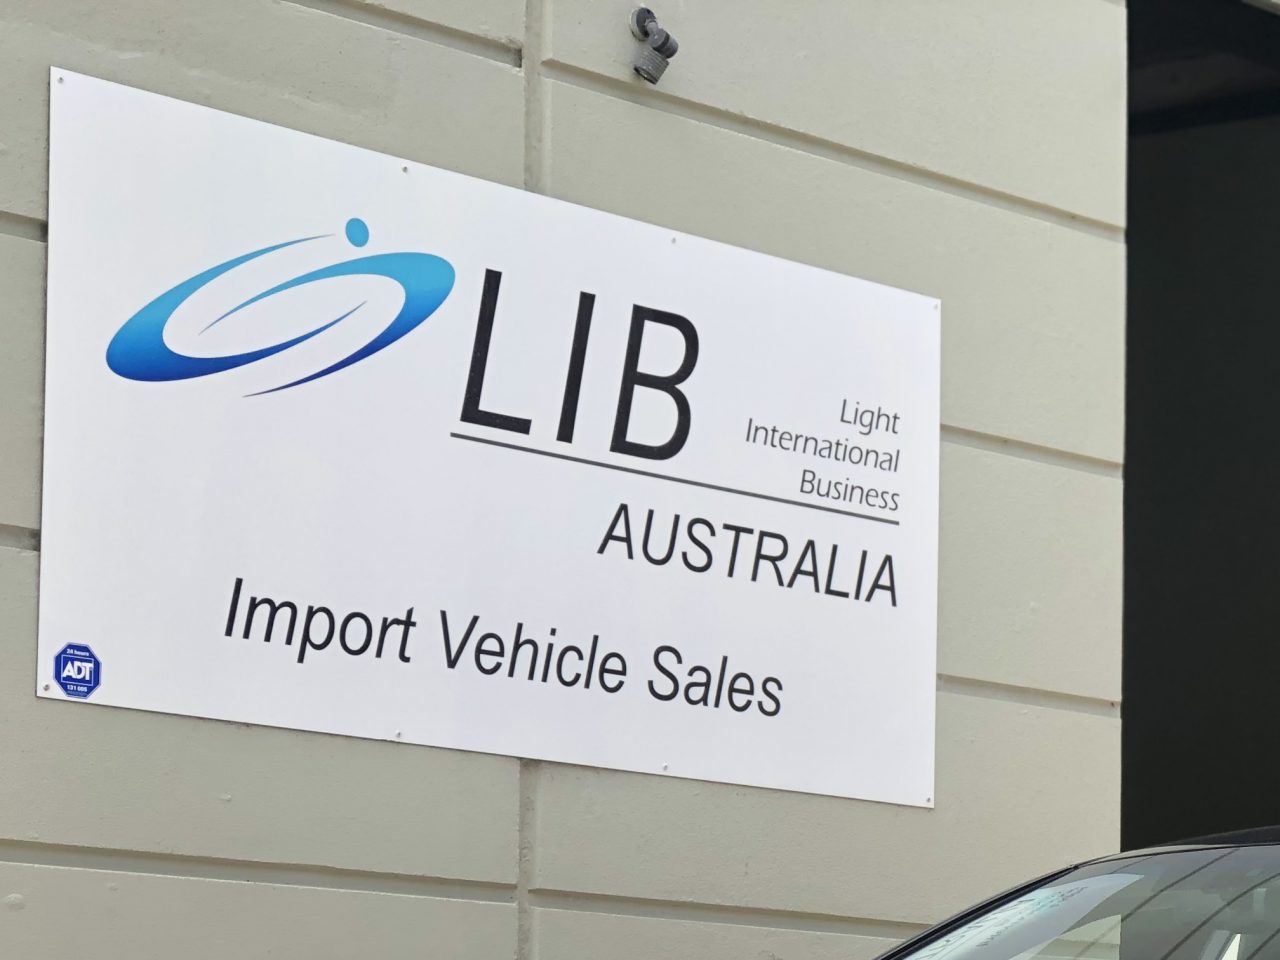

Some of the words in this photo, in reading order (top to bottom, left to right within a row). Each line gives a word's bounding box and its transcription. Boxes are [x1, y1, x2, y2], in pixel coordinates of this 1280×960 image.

[459, 268, 700, 461] LIB
[745, 417, 900, 473] International
[840, 398, 900, 436] Light
[799, 469, 900, 512] Business
[597, 503, 897, 607] AUSTRALIA
[62, 660, 94, 681] ADT
[224, 577, 417, 664] Import
[440, 609, 627, 694] Vehicle
[647, 645, 783, 717] Sales
